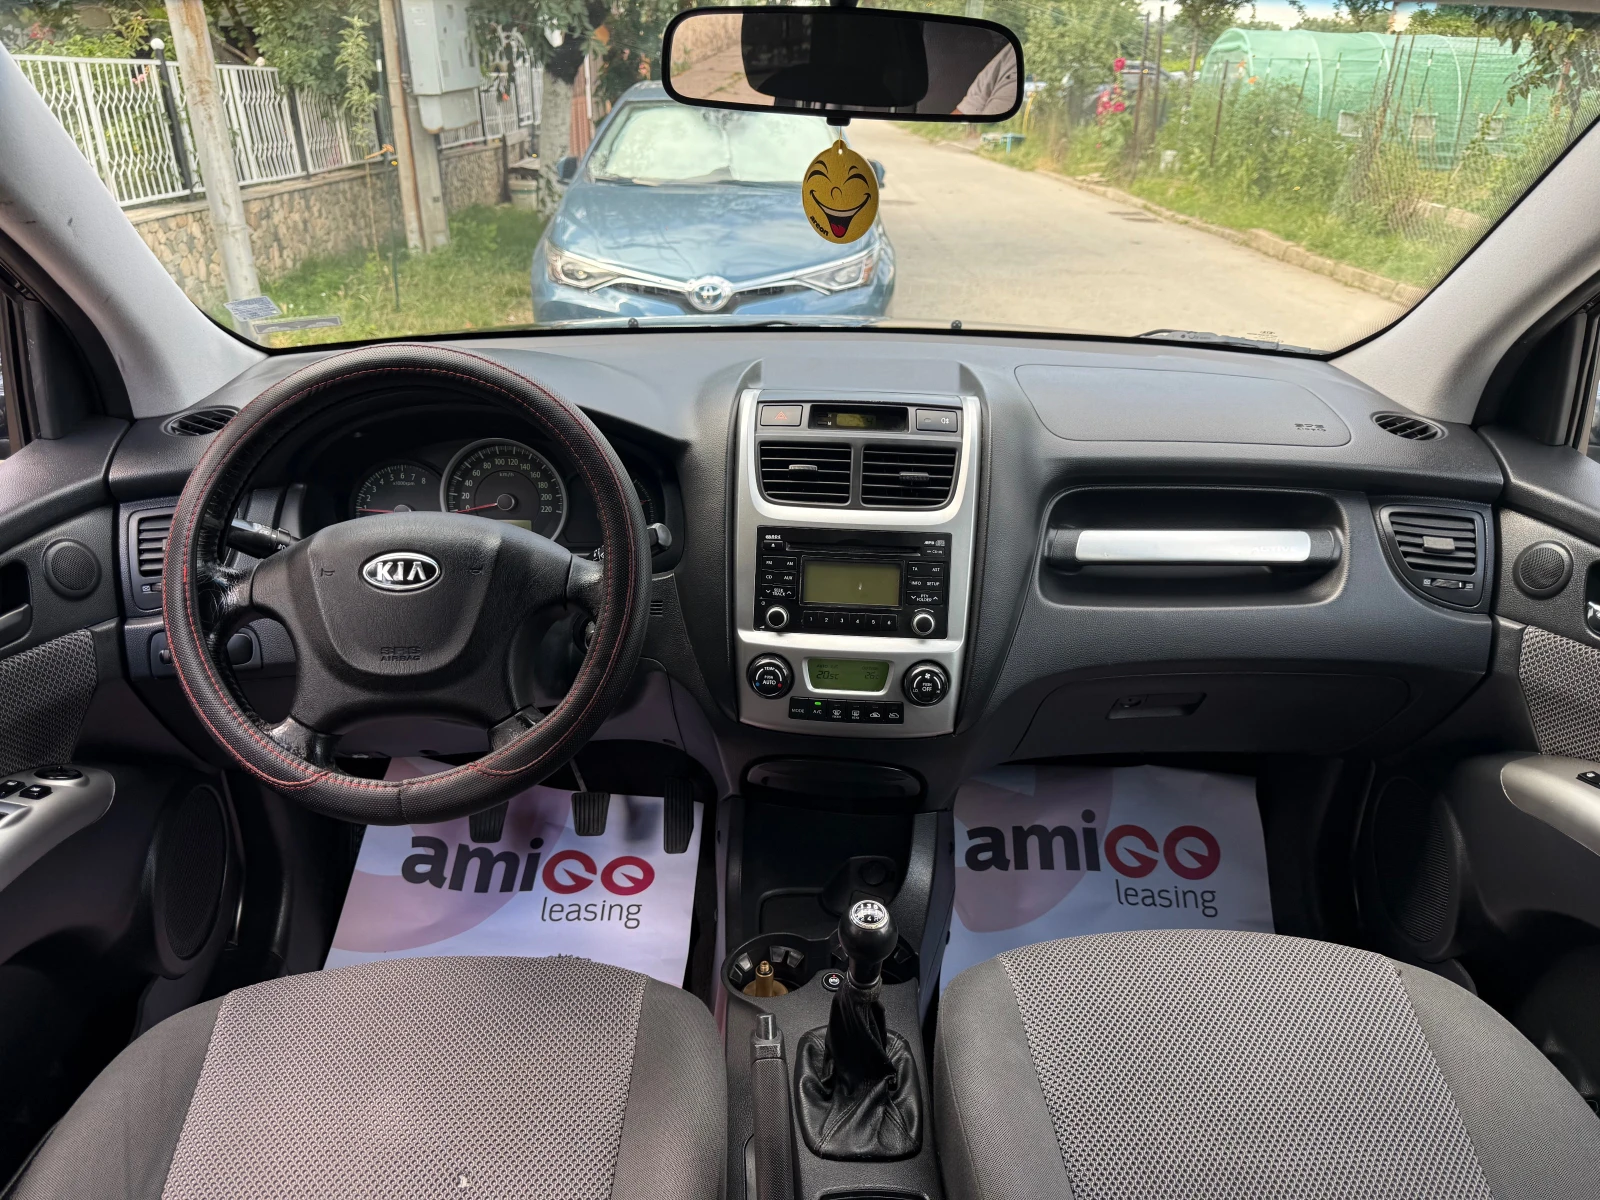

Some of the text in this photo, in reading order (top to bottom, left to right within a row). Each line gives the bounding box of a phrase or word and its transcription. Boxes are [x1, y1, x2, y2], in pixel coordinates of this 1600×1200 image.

[810, 215, 828, 236] areon
[376, 561, 426, 582] KIA
[1115, 878, 1218, 918] leasing
[541, 896, 642, 930] leasing
